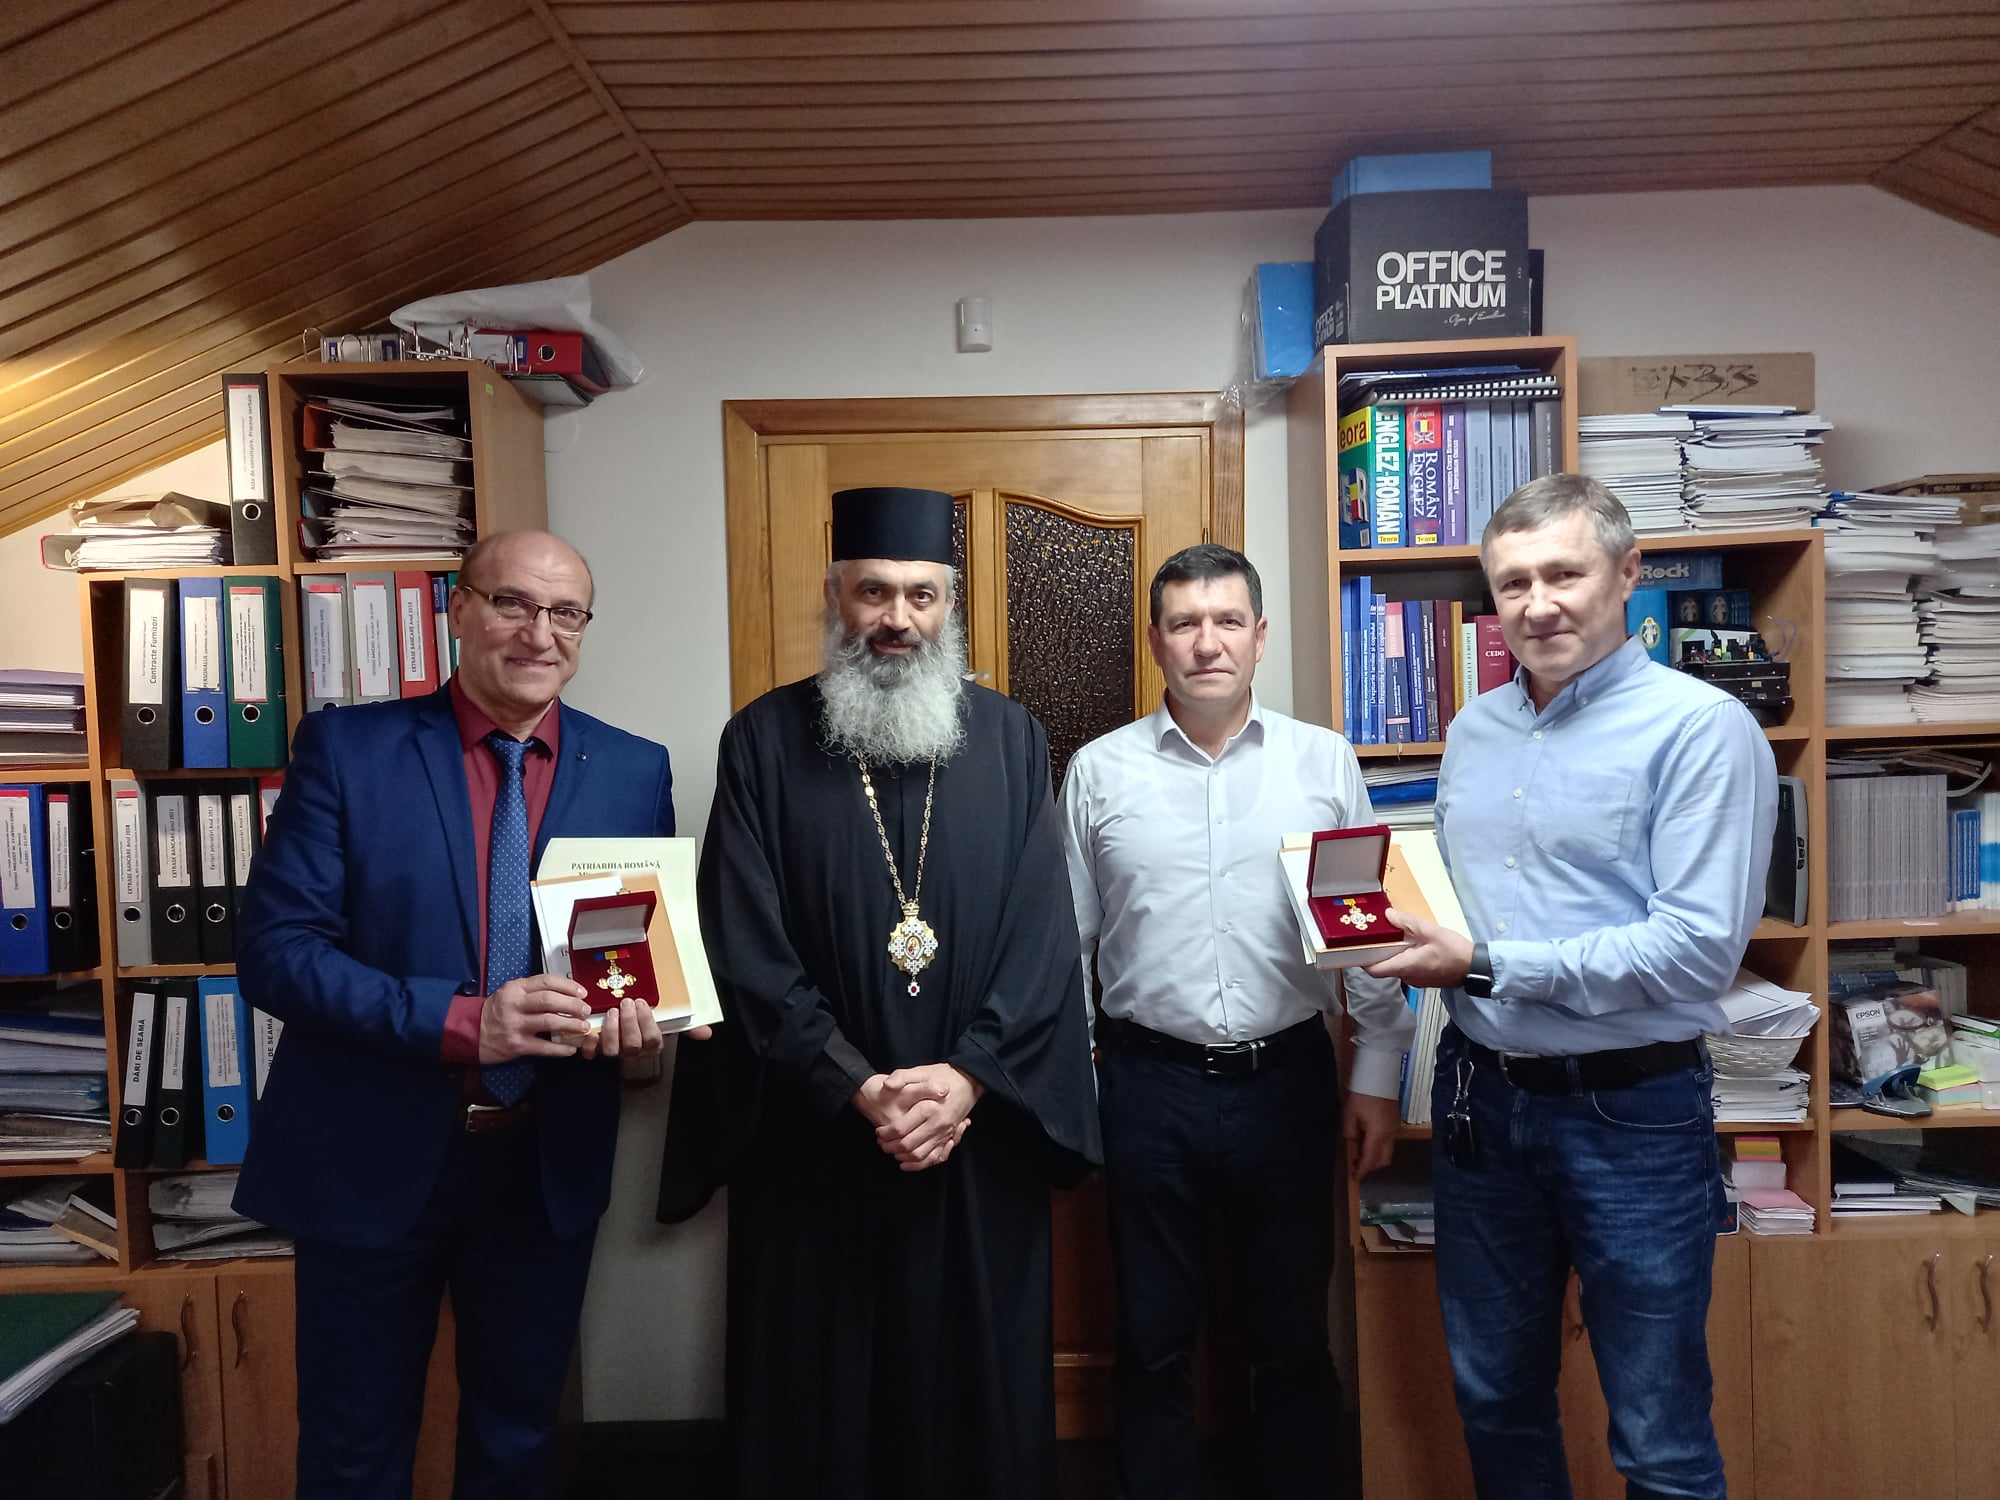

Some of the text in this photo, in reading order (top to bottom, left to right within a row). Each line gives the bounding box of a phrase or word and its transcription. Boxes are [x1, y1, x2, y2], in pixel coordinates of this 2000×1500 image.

[1376, 249, 1506, 284] OFFICE
[1376, 282, 1506, 310] PLATINUM
[1338, 420, 1367, 450] eora
[1375, 410, 1404, 533] ENGLEZ-ROMÂN
[1412, 452, 1425, 517] ENGLEZ
[1425, 451, 1441, 519] ROMÂN
[1378, 534, 1399, 543] Teora
[149, 616, 158, 684] Contracte Furnizori
[571, 860, 661, 870] PATRIARHIA ROMÂNĂ
[1855, 1008, 1881, 1019] EPSON
[266, 1017, 274, 1045] SEAMĂ
[132, 1019, 146, 1083] DĂRI DE SEAMĂ
[267, 1047, 274, 1057] DE
